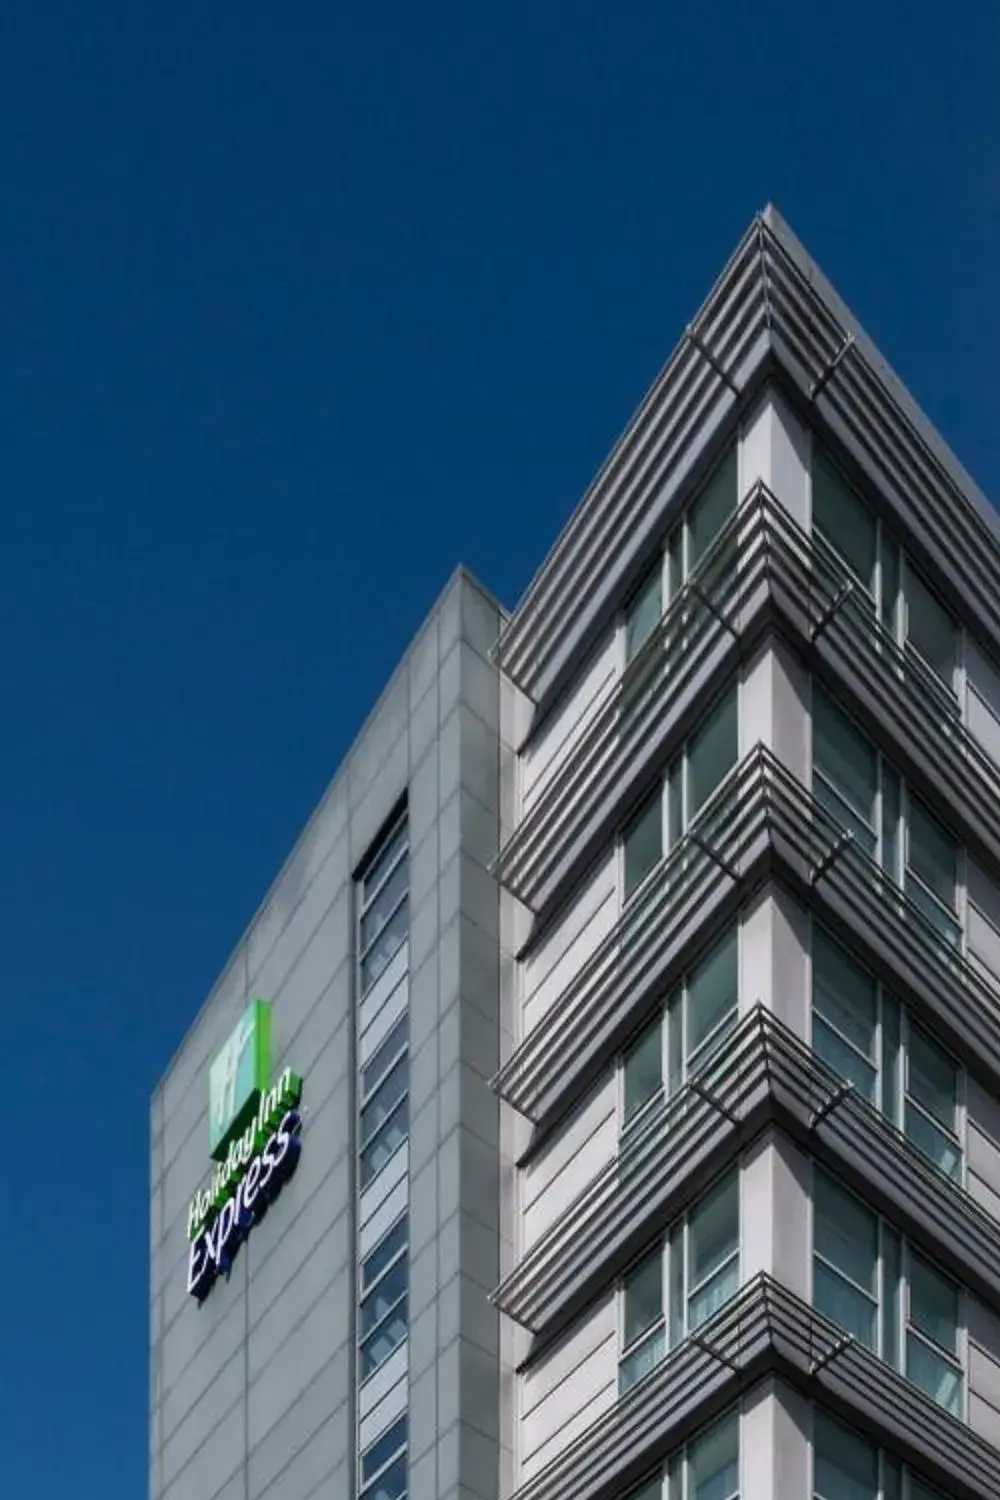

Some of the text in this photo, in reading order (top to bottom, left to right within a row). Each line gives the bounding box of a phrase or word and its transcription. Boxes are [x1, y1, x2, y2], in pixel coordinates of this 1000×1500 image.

[187, 1065, 294, 1239] Holiday Inn
[187, 1110, 301, 1294] Express
